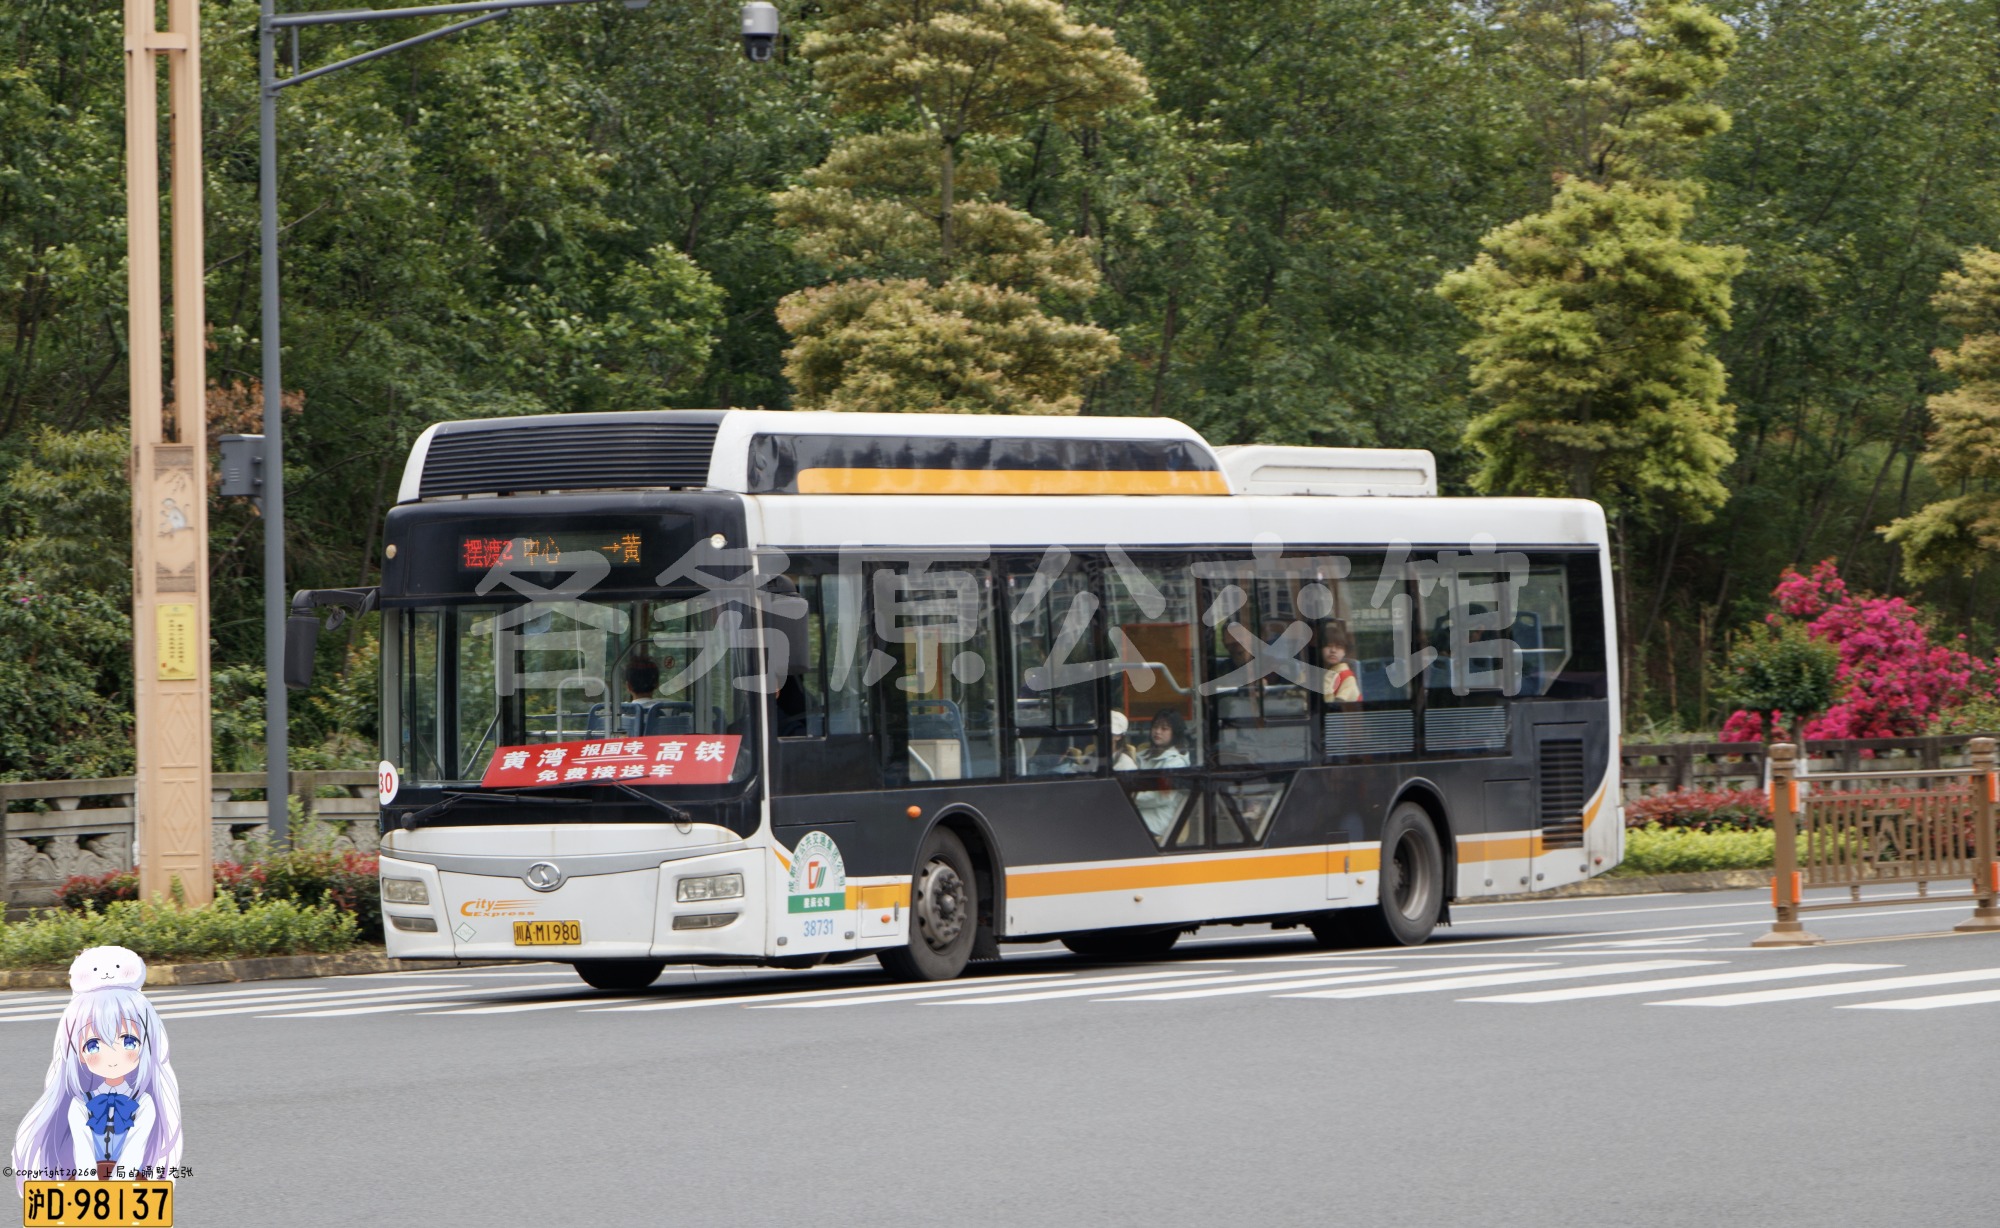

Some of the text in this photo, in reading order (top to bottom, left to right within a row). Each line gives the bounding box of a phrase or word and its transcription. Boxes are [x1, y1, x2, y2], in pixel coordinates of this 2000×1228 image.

[523, 536, 560, 566] 中心
[621, 533, 642, 563] 黄
[500, 740, 727, 771] 黄湾 报国寺 高铁
[536, 764, 675, 783] 免费接送车
[460, 898, 495, 917] City
[803, 919, 834, 937] 38731
